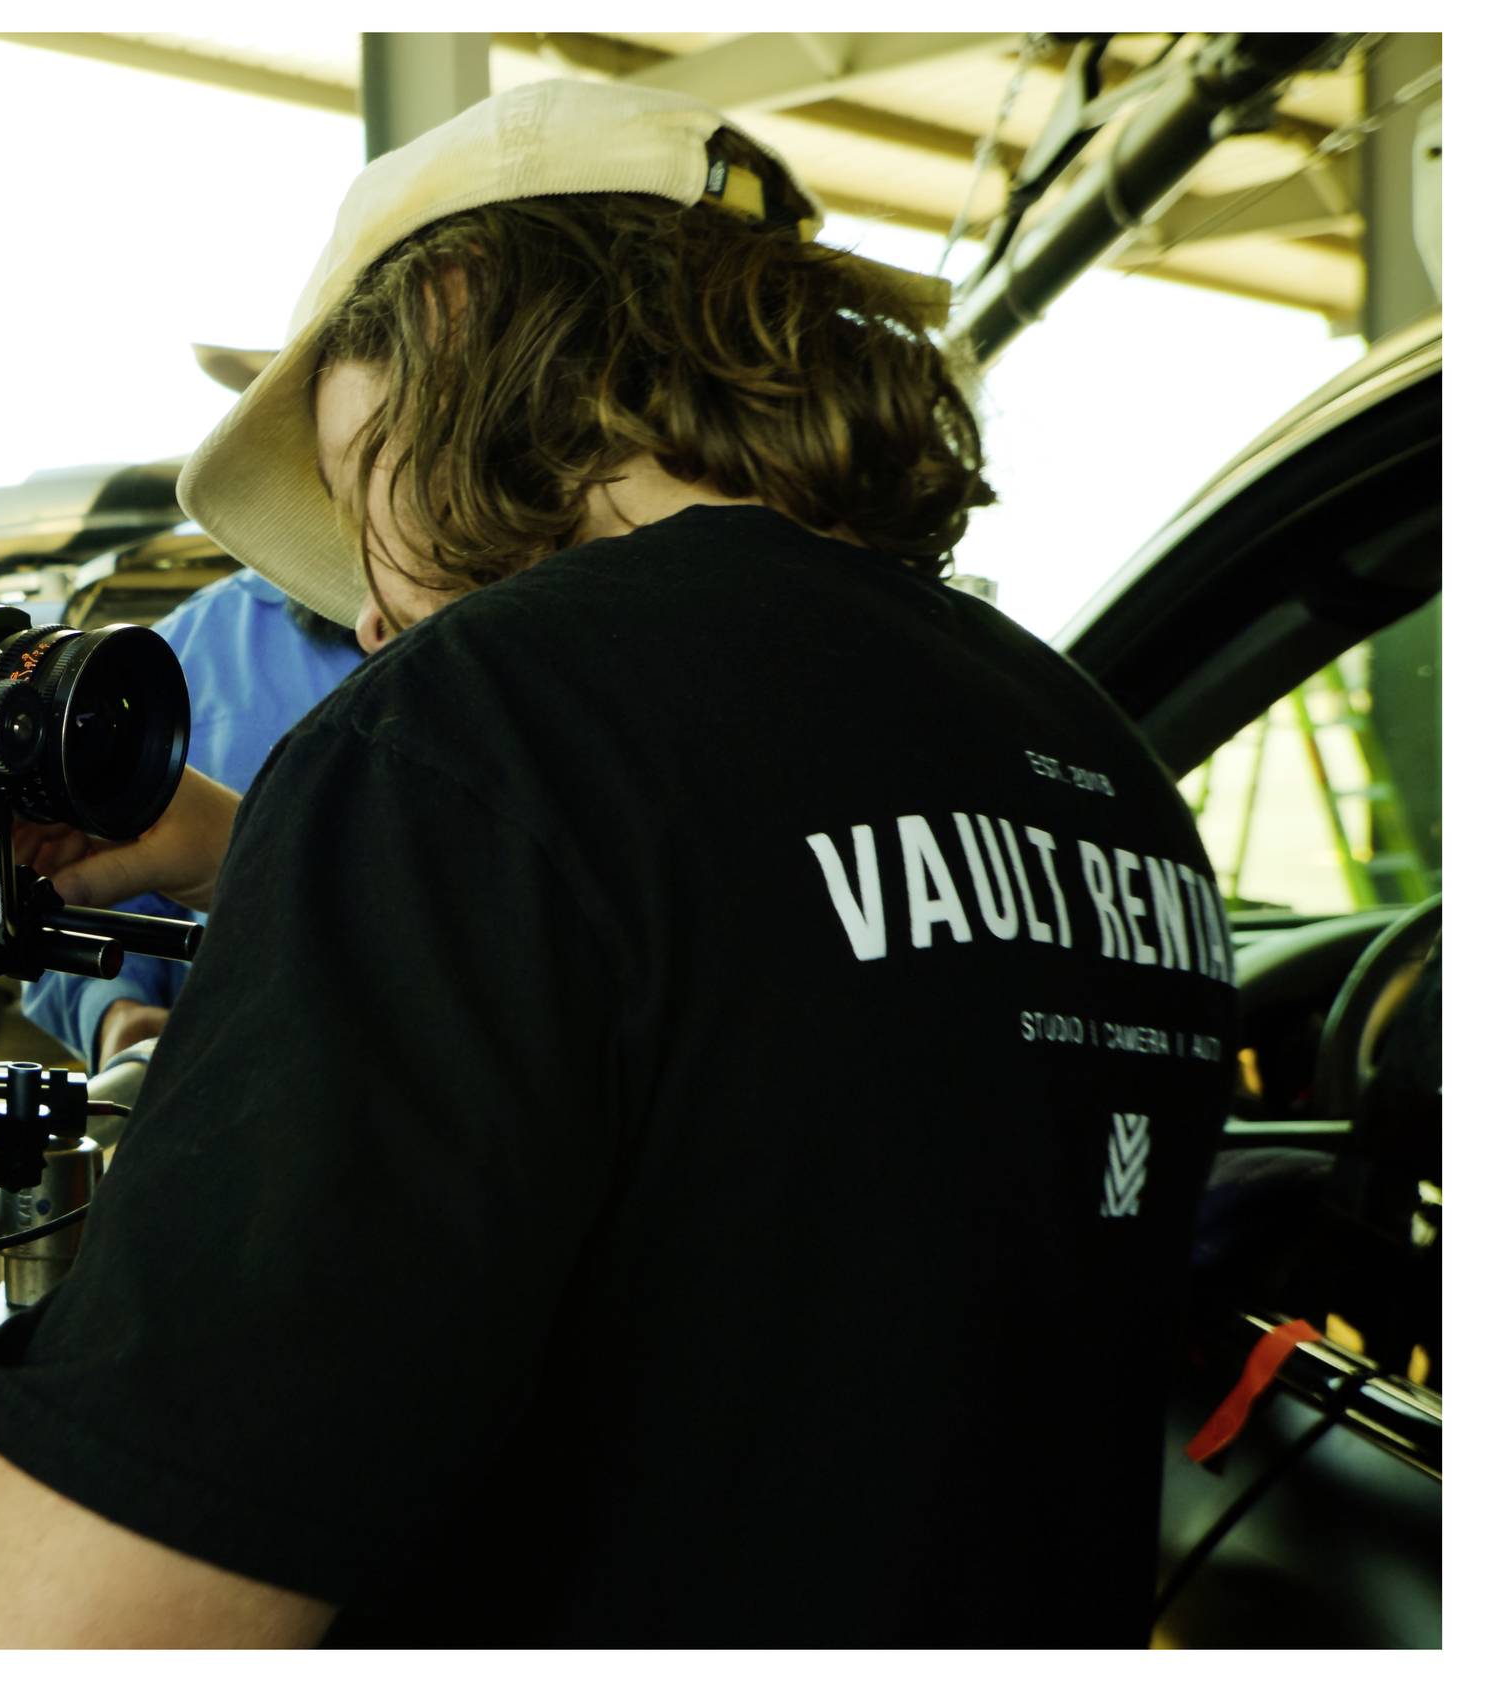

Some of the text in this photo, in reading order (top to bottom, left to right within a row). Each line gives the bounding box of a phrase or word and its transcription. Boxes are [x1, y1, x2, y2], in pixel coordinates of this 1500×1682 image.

[806, 812, 1073, 961] VAULT
[1020, 1010, 1084, 1045] STUDIO
[1103, 1021, 1170, 1055] CAMERA
